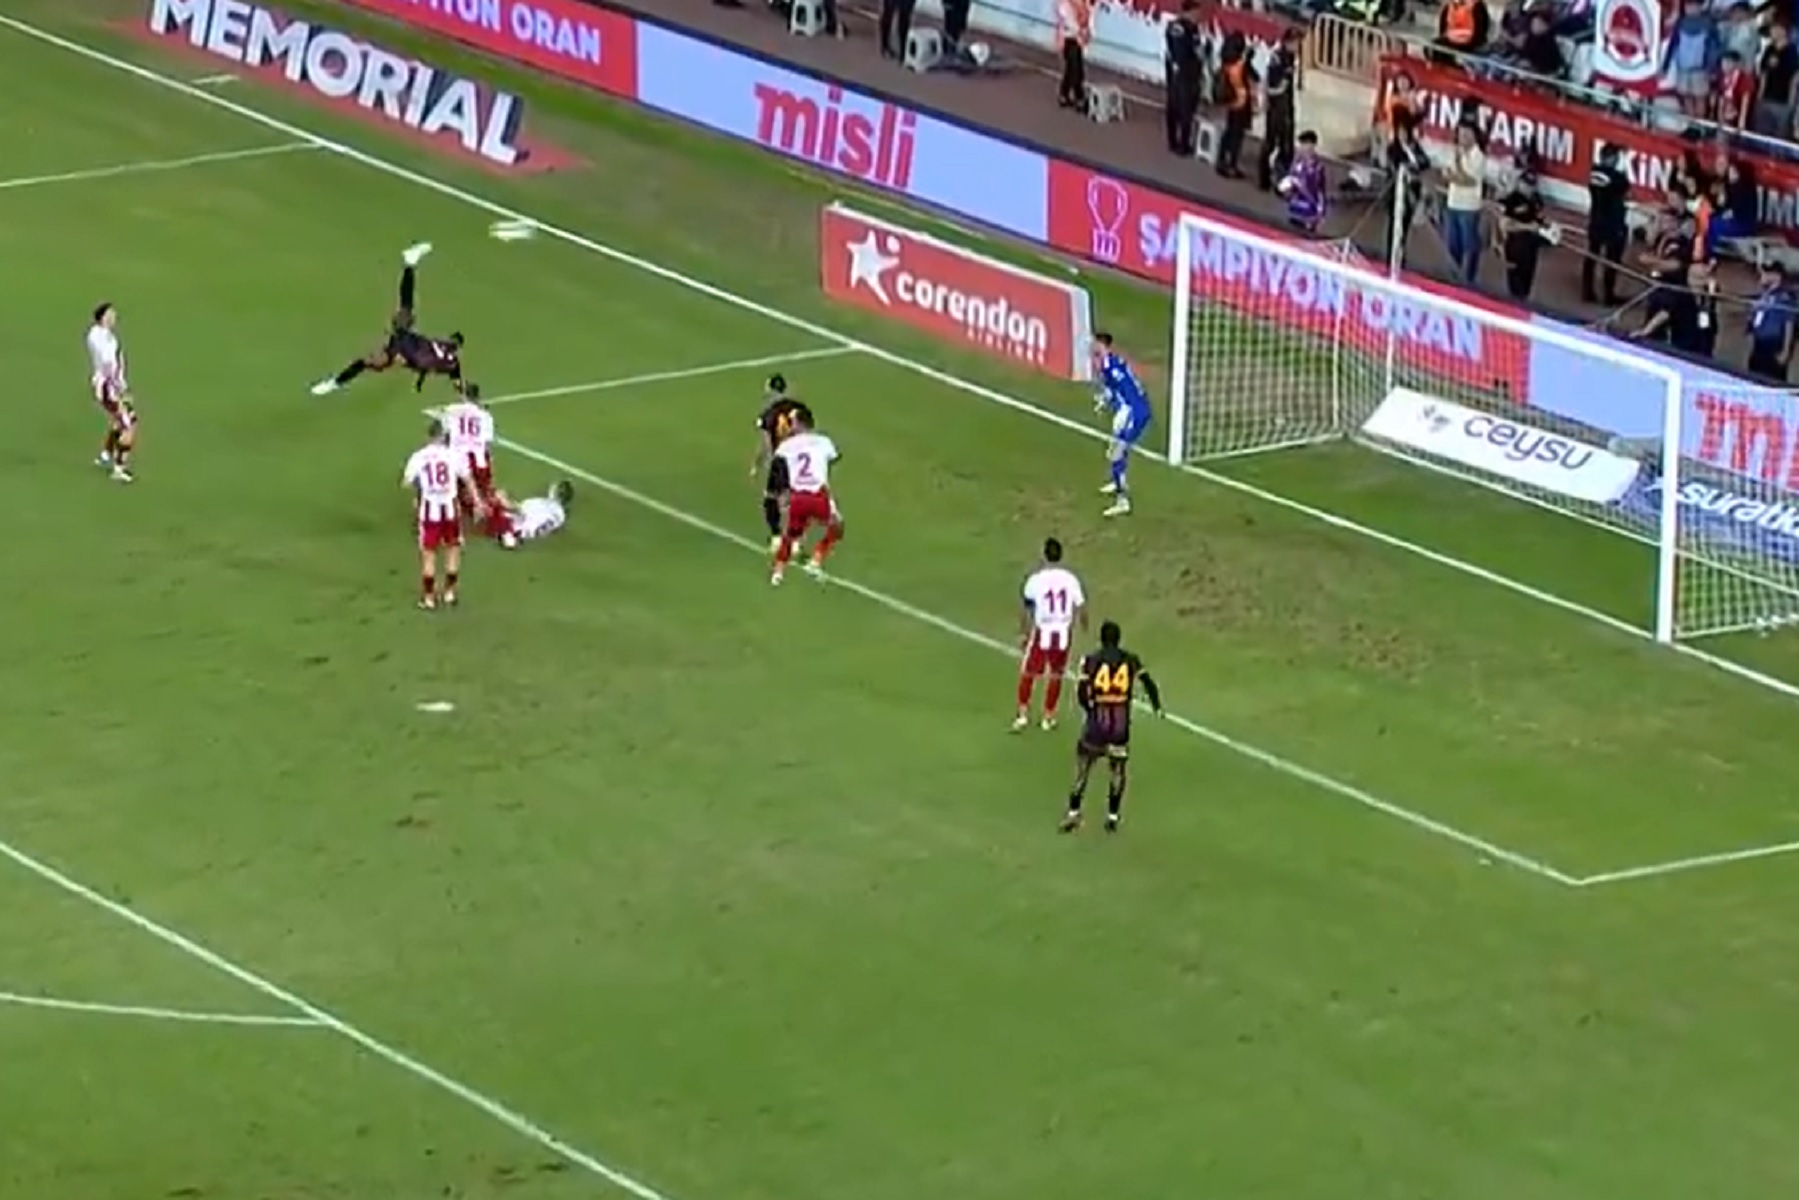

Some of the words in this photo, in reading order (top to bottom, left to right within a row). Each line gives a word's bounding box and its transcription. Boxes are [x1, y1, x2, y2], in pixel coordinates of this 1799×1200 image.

[511, 4, 600, 65] ORAN
[150, 0, 519, 165] MEMORIAL
[755, 83, 916, 189] misli
[896, 271, 1048, 351] corendon
[458, 415, 481, 437] 16
[1463, 414, 1596, 471] ceysu
[424, 461, 449, 487] 18
[797, 452, 813, 478] 2
[1044, 587, 1068, 615] 11
[1095, 662, 1130, 692] 44
